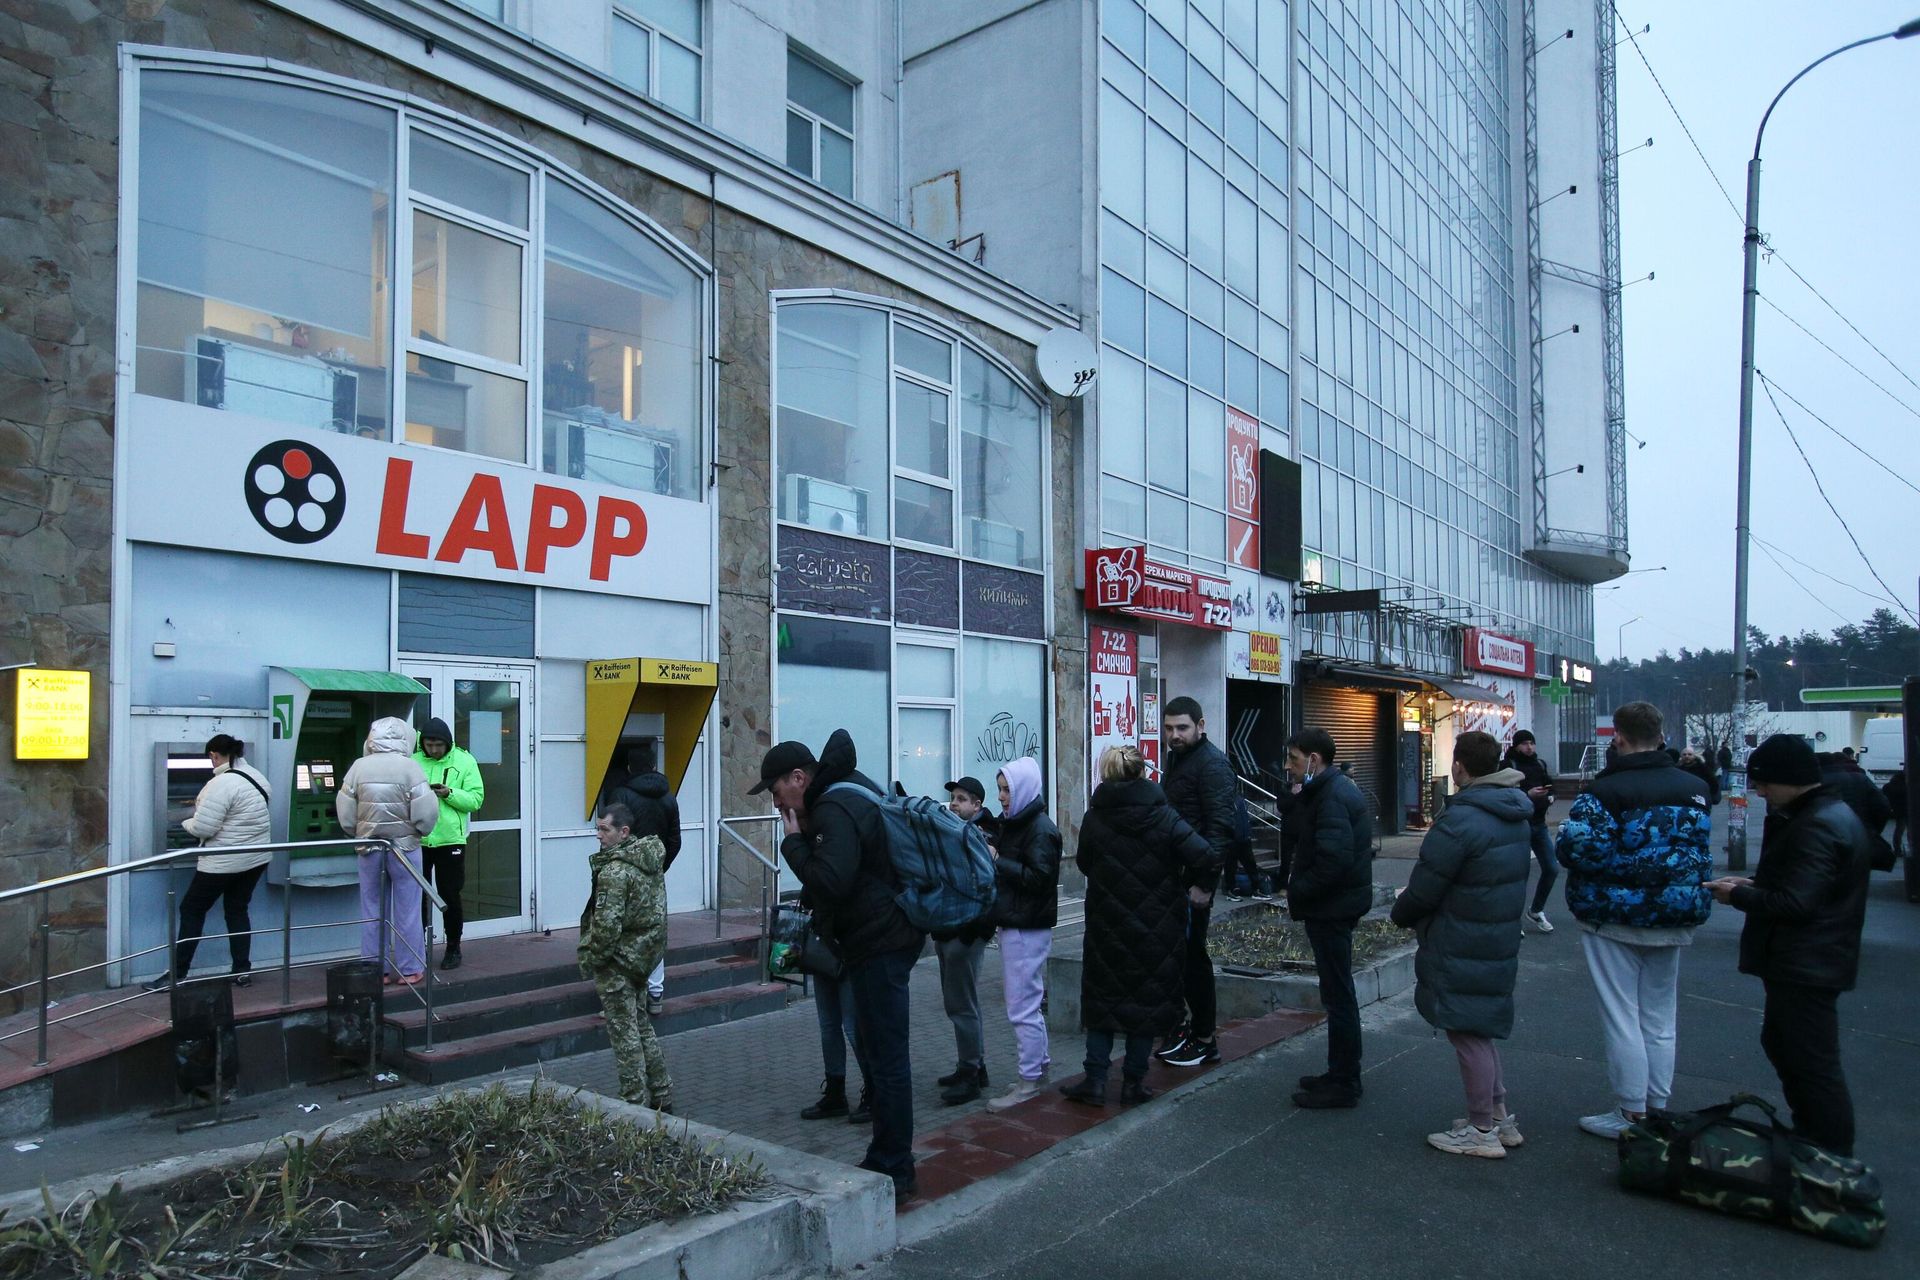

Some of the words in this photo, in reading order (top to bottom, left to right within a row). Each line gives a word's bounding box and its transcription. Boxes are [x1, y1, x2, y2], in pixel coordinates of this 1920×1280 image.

[375, 456, 648, 582] LAPP
[1144, 564, 1165, 579] ЕРЕЖА
[1165, 569, 1192, 584] МАРКЕТІВ
[1202, 602, 1231, 627] 7-22
[1101, 630, 1127, 652] 7-22
[1251, 633, 1279, 657] ОРЕНДА
[604, 663, 631, 671] Raiffeisen
[671, 664, 703, 673] Raiffeisen
[1096, 652, 1131, 674] СМАЧНО
[604, 672, 621, 680] BANK
[671, 673, 691, 681] BANK
